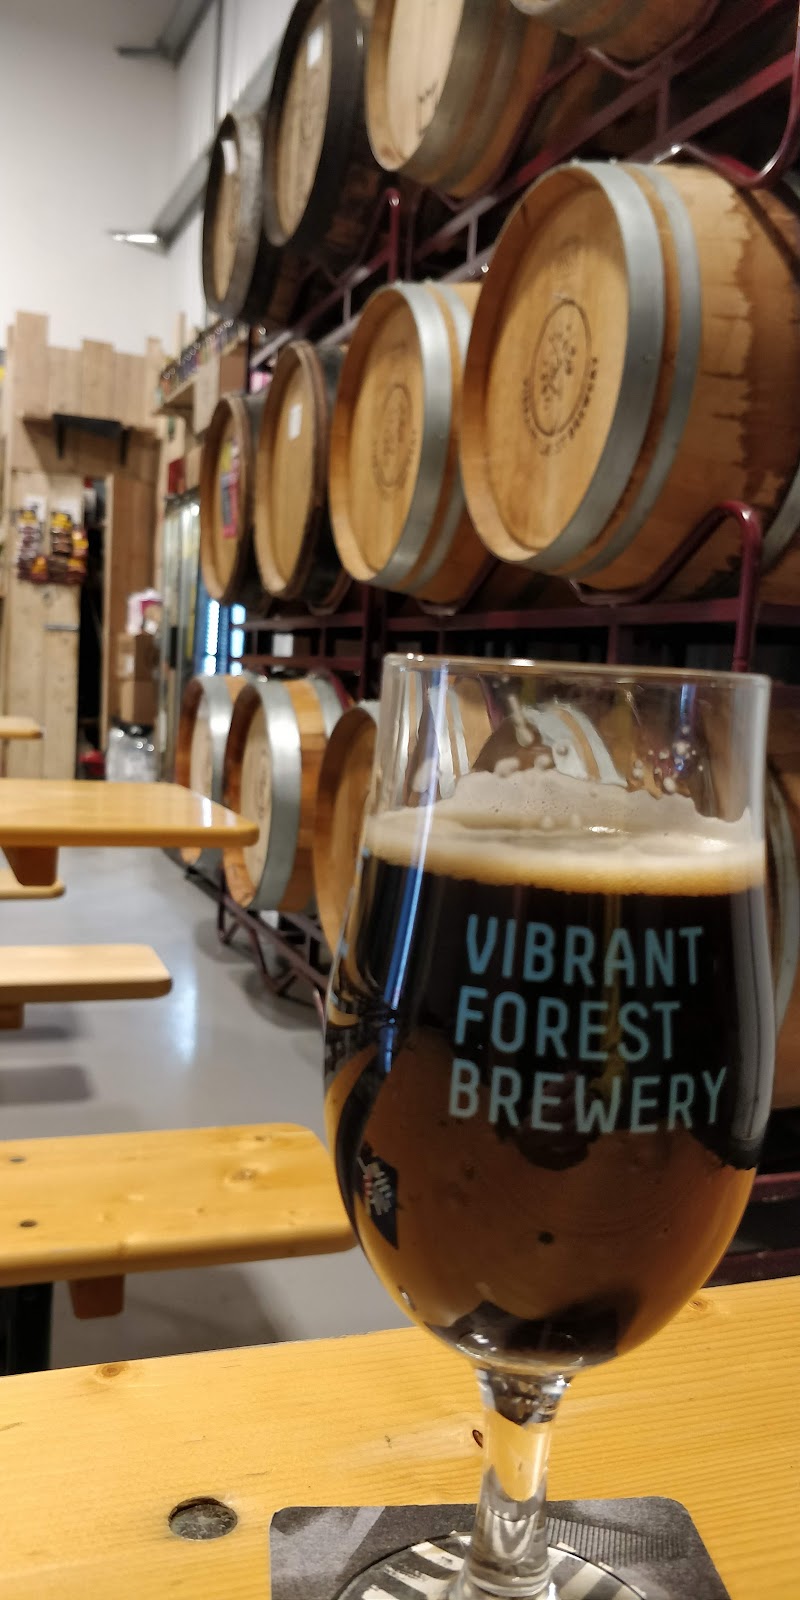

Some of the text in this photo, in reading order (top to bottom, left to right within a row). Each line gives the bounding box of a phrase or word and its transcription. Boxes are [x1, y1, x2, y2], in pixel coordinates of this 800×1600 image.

[466, 913, 703, 987] VIBRANT
[455, 985, 681, 1062] FOREST
[449, 1058, 728, 1134] BREWERY
